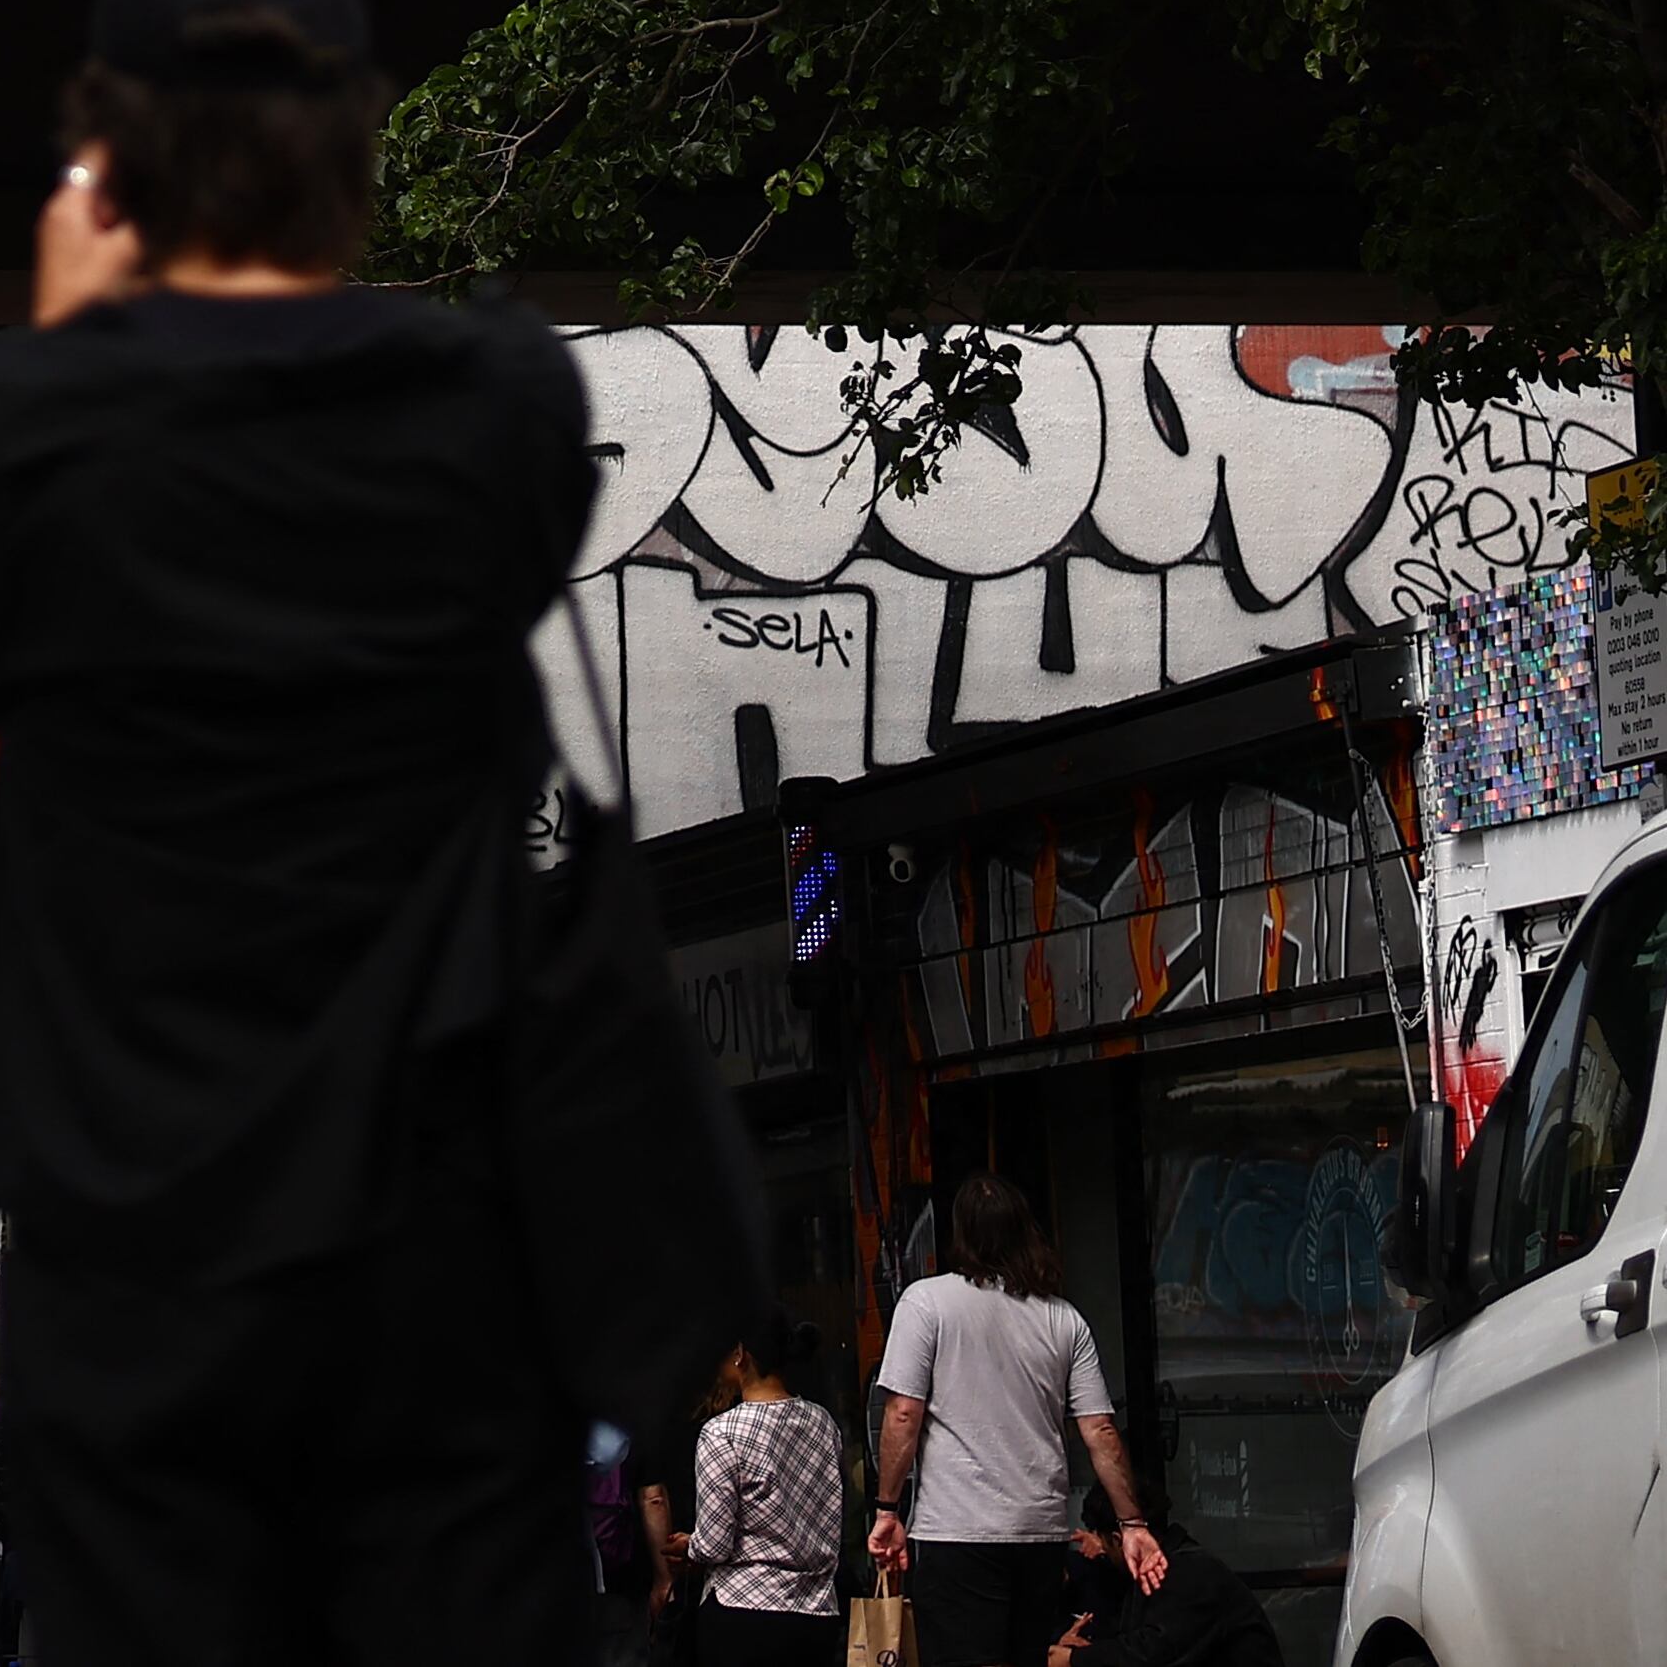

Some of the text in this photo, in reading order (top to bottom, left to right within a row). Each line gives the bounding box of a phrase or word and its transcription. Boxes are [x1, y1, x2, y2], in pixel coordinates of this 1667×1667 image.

[1610, 608, 1654, 632] Pay by phone
[1634, 650, 1662, 668] location
[1608, 693, 1666, 718] Max stay 2 hours
[1621, 717, 1653, 735] No return
[1617, 739, 1637, 757] within
[1644, 736, 1659, 751] hour
